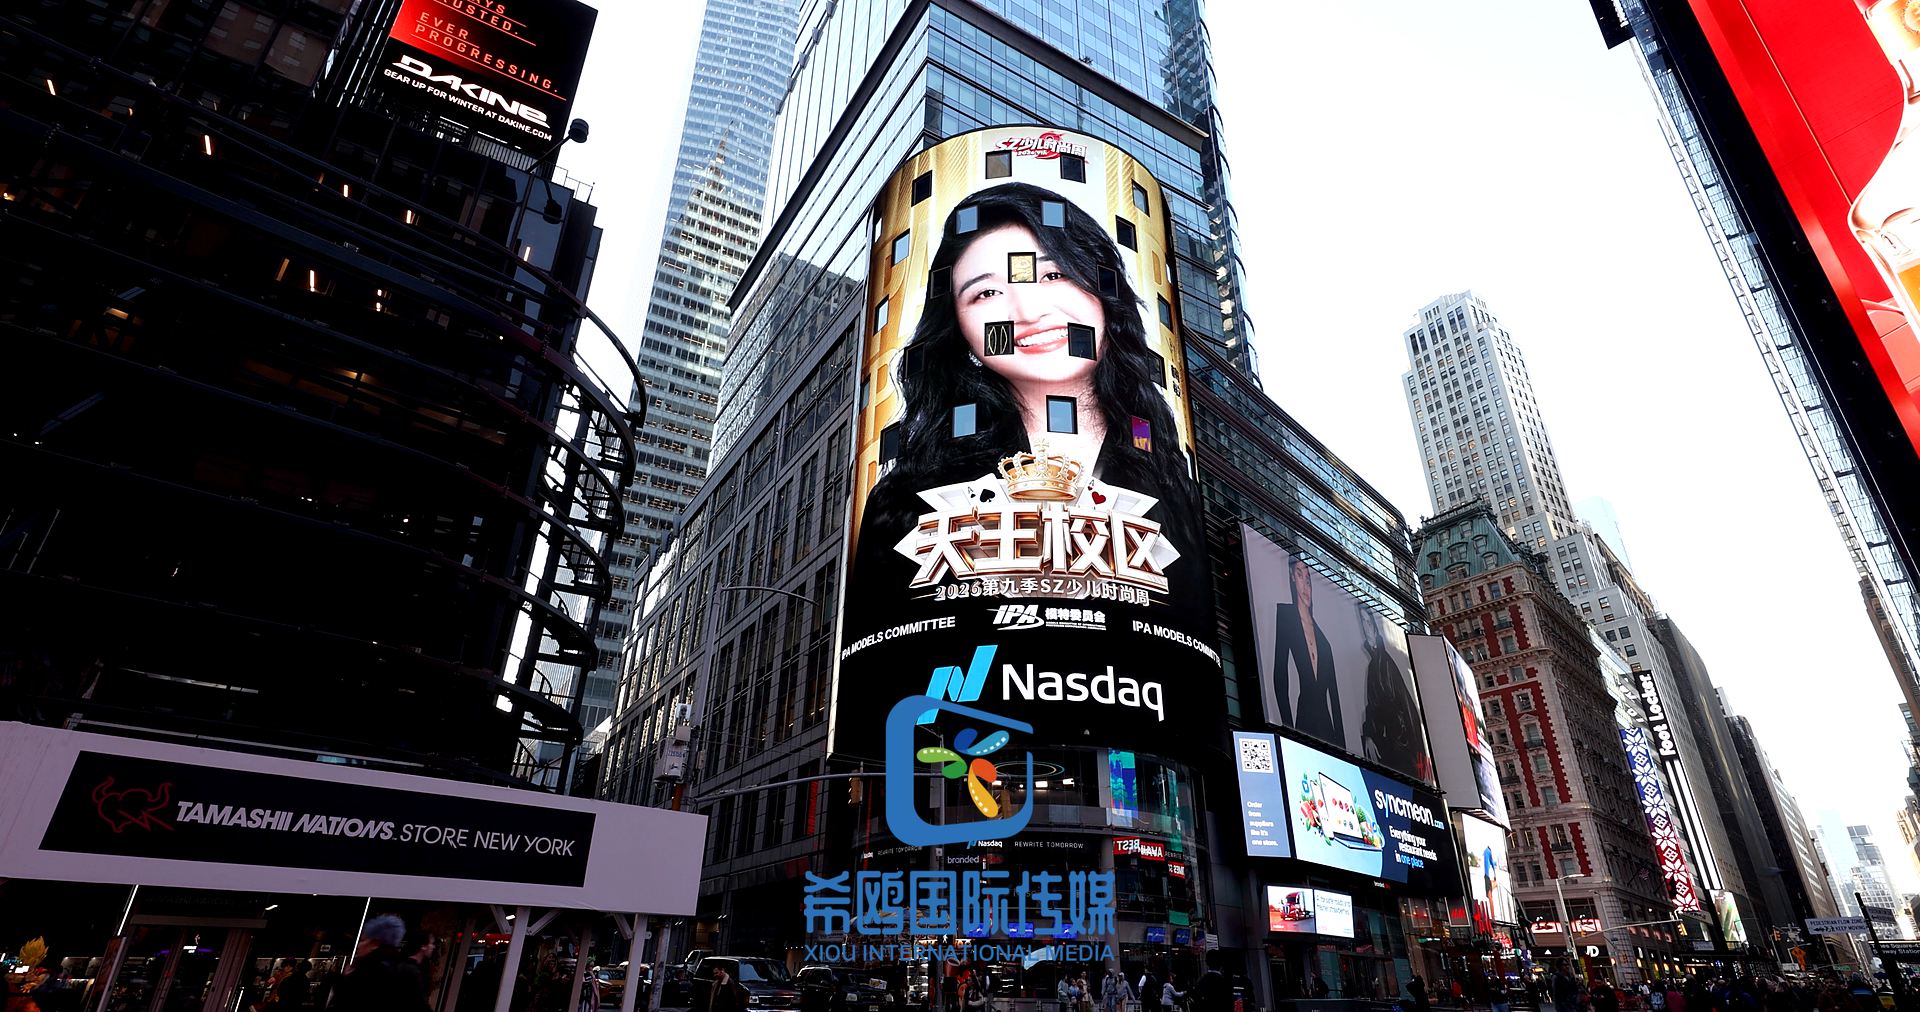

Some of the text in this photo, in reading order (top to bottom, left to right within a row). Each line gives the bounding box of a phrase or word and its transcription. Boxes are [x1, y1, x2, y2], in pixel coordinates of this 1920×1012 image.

[420, 12, 469, 39] EVER
[443, 0, 518, 35] USTED.
[414, 24, 558, 93] PROGRESSING.
[384, 68, 552, 141] GEAR UP FOR WINTER AT DAKINE.COM
[392, 54, 551, 129] DAKINE
[909, 504, 1169, 594] 天王校区
[993, 604, 1039, 625] IPA
[851, 631, 884, 655] MODELS
[884, 616, 956, 640] COMMITTEE
[1132, 620, 1152, 634] IPA
[1153, 624, 1192, 647] MODELS
[1002, 664, 1164, 722] Nasdaq
[1639, 673, 1676, 756] Foot Locker
[176, 800, 576, 857] TAMASHII NATIONS STORE NEW YORK
[977, 840, 1003, 849] Nasdaq
[1047, 841, 1084, 849] TOMORROW
[1389, 825, 1417, 846] Everything
[947, 855, 980, 864] branded
